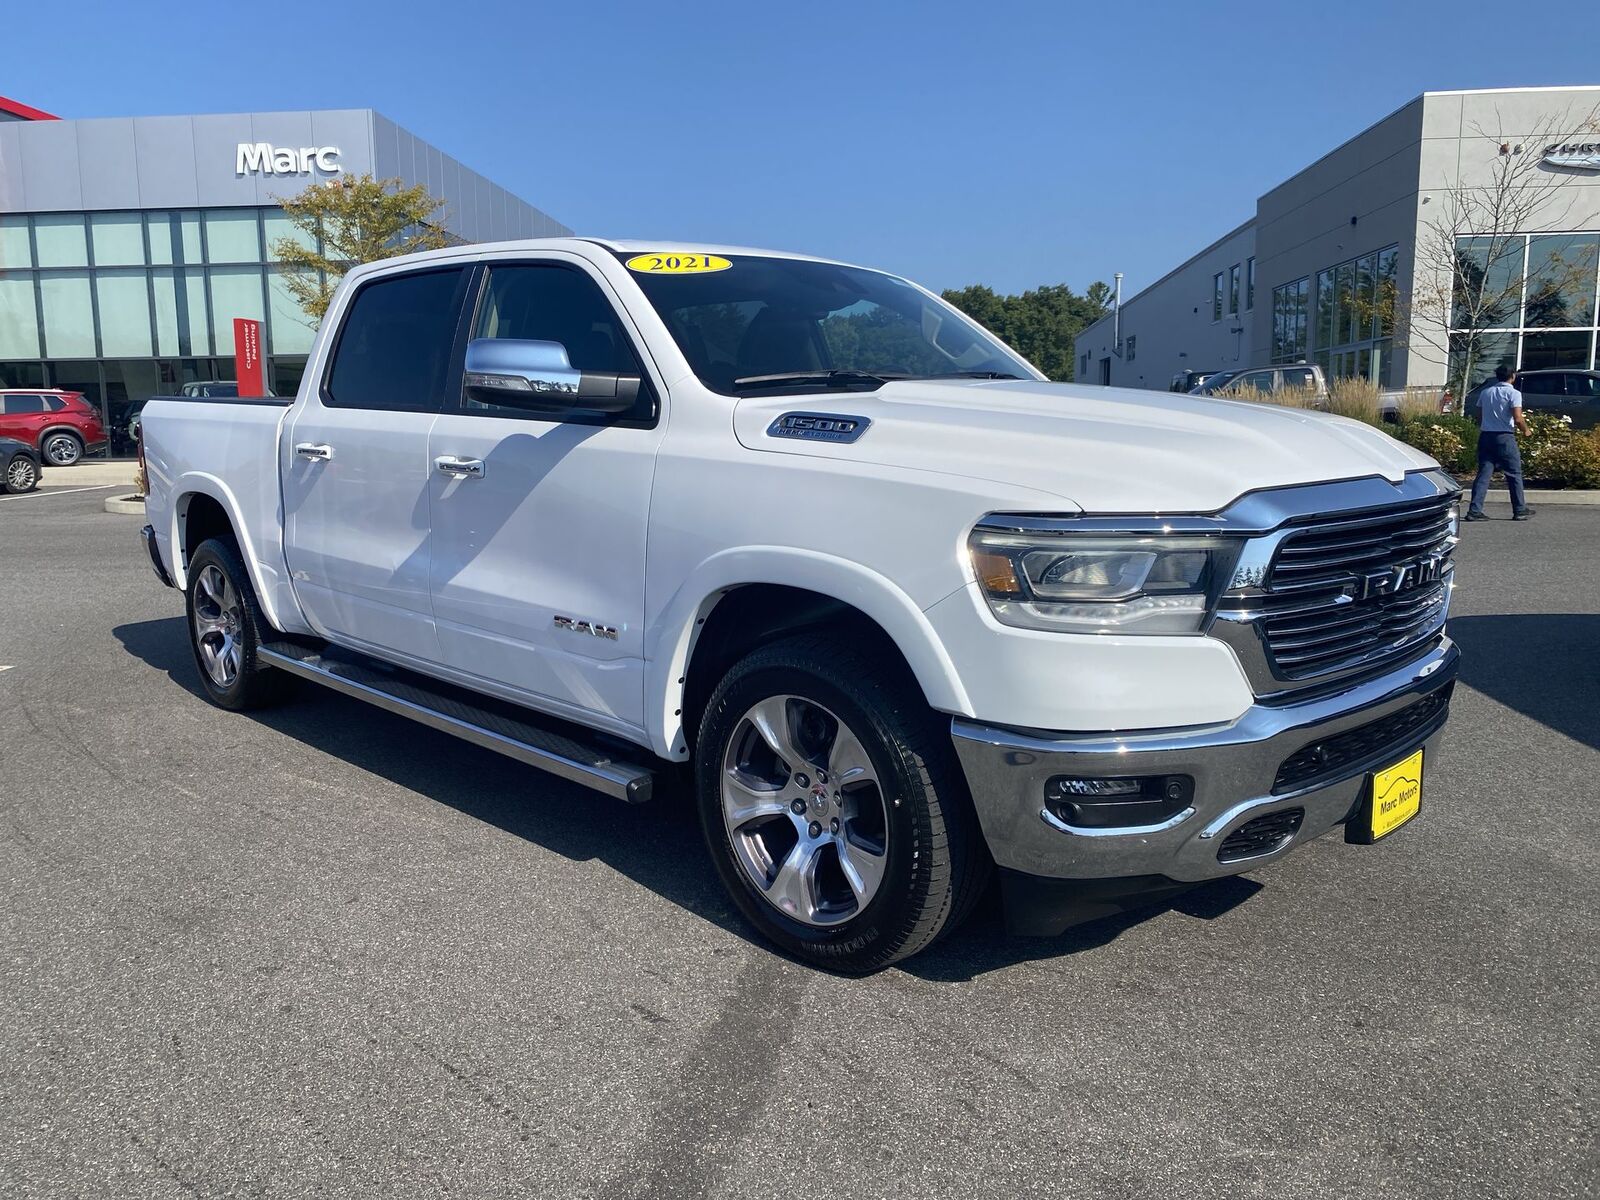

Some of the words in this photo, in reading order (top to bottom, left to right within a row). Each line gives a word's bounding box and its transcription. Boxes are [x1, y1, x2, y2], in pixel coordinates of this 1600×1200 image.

[236, 143, 341, 174] Marc
[649, 256, 711, 270] 2021
[244, 322, 252, 369] Customer
[781, 416, 857, 432] 1500
[1362, 557, 1442, 600] RAM
[553, 615, 618, 641] RAM
[1380, 798, 1398, 816] Marc
[1399, 785, 1418, 806] Motors
